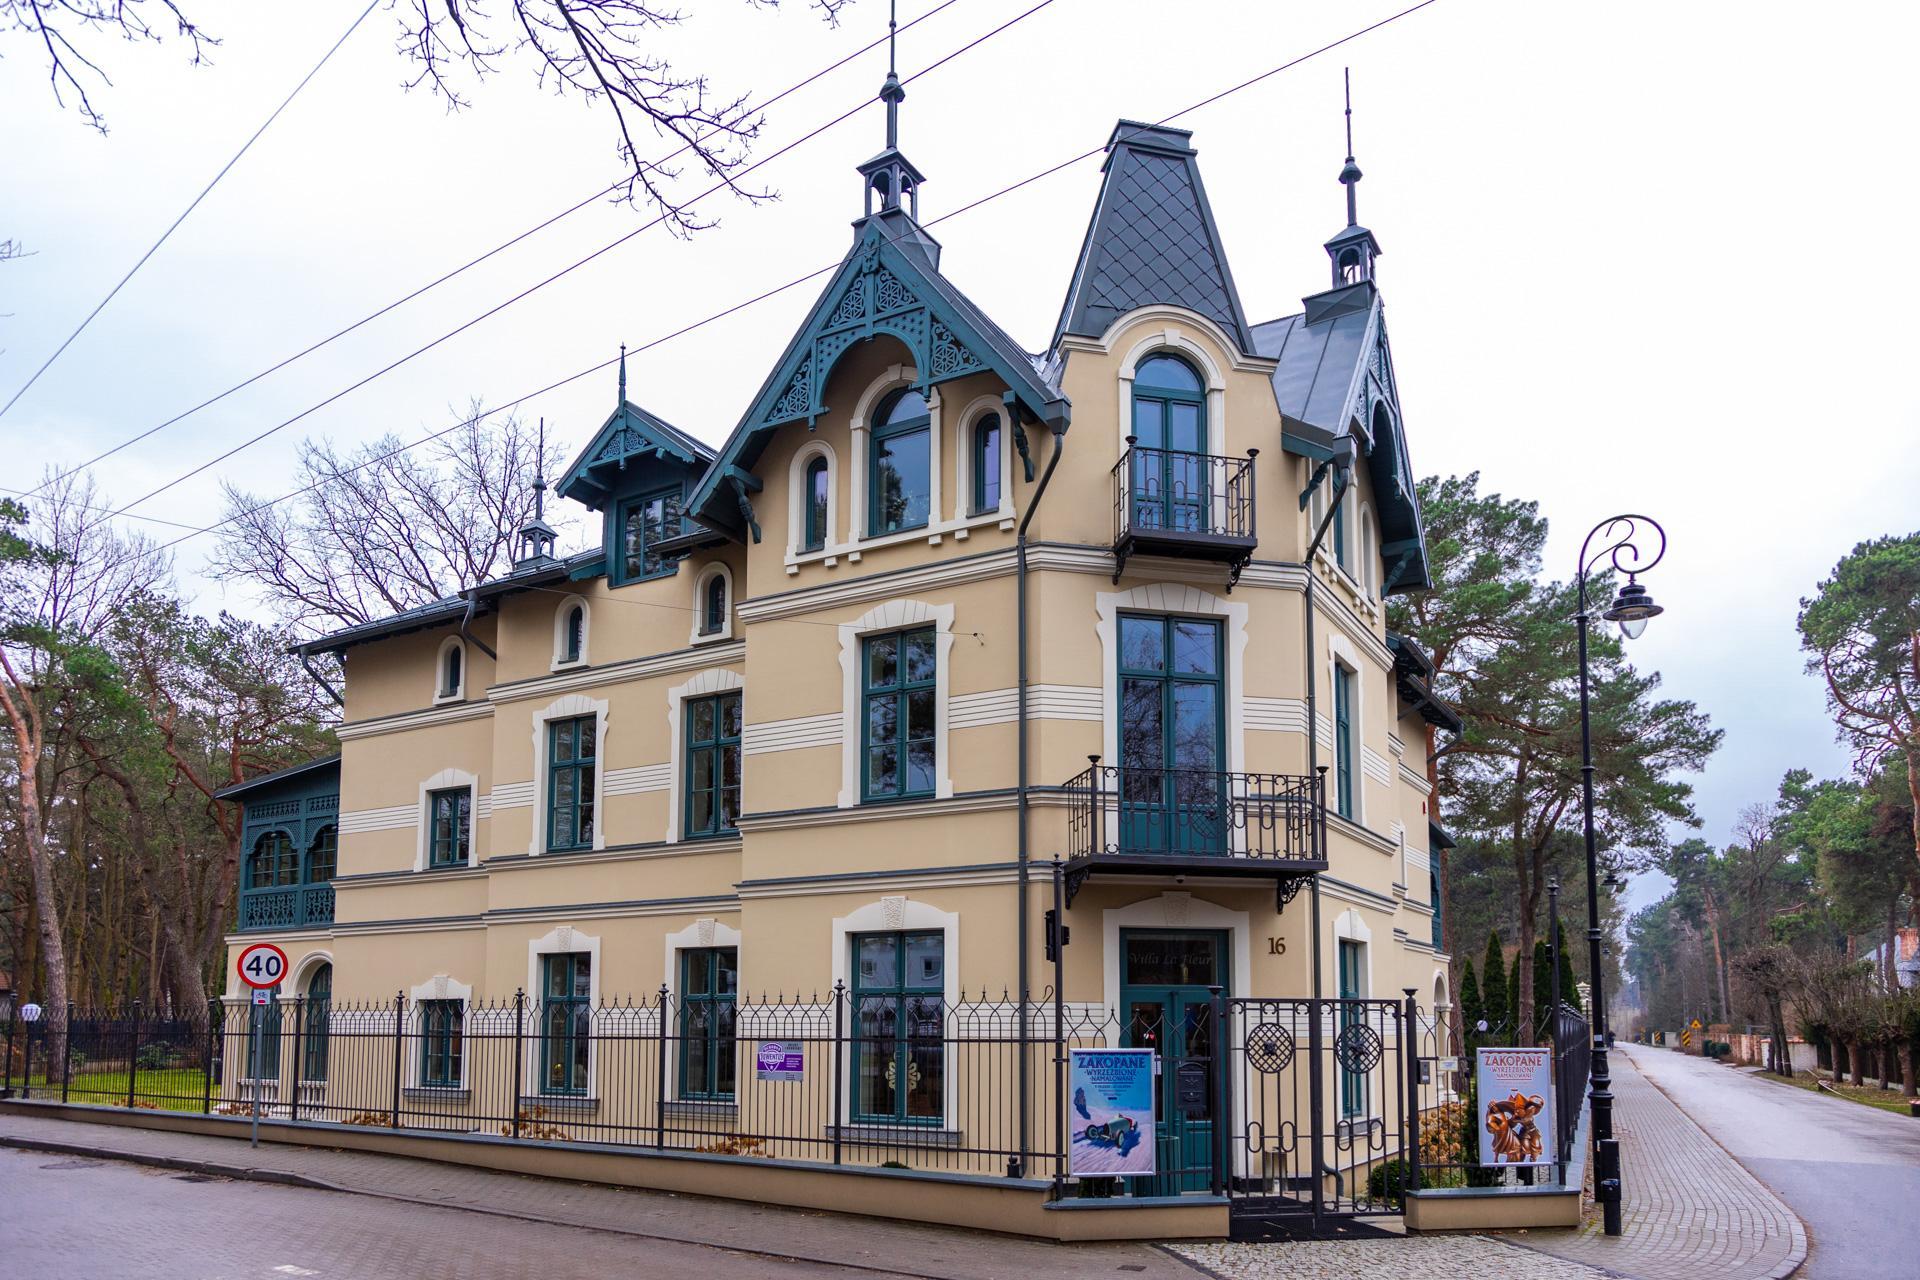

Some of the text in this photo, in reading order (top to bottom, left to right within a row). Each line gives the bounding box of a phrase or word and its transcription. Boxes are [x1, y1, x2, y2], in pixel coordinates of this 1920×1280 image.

[1268, 937, 1286, 955] 16
[1128, 952, 1212, 965] Villa La Fleur
[246, 956, 281, 976] 40
[1078, 1056, 1146, 1068] ZAKOPANE
[1485, 1056, 1542, 1066] ZAKOPANE
